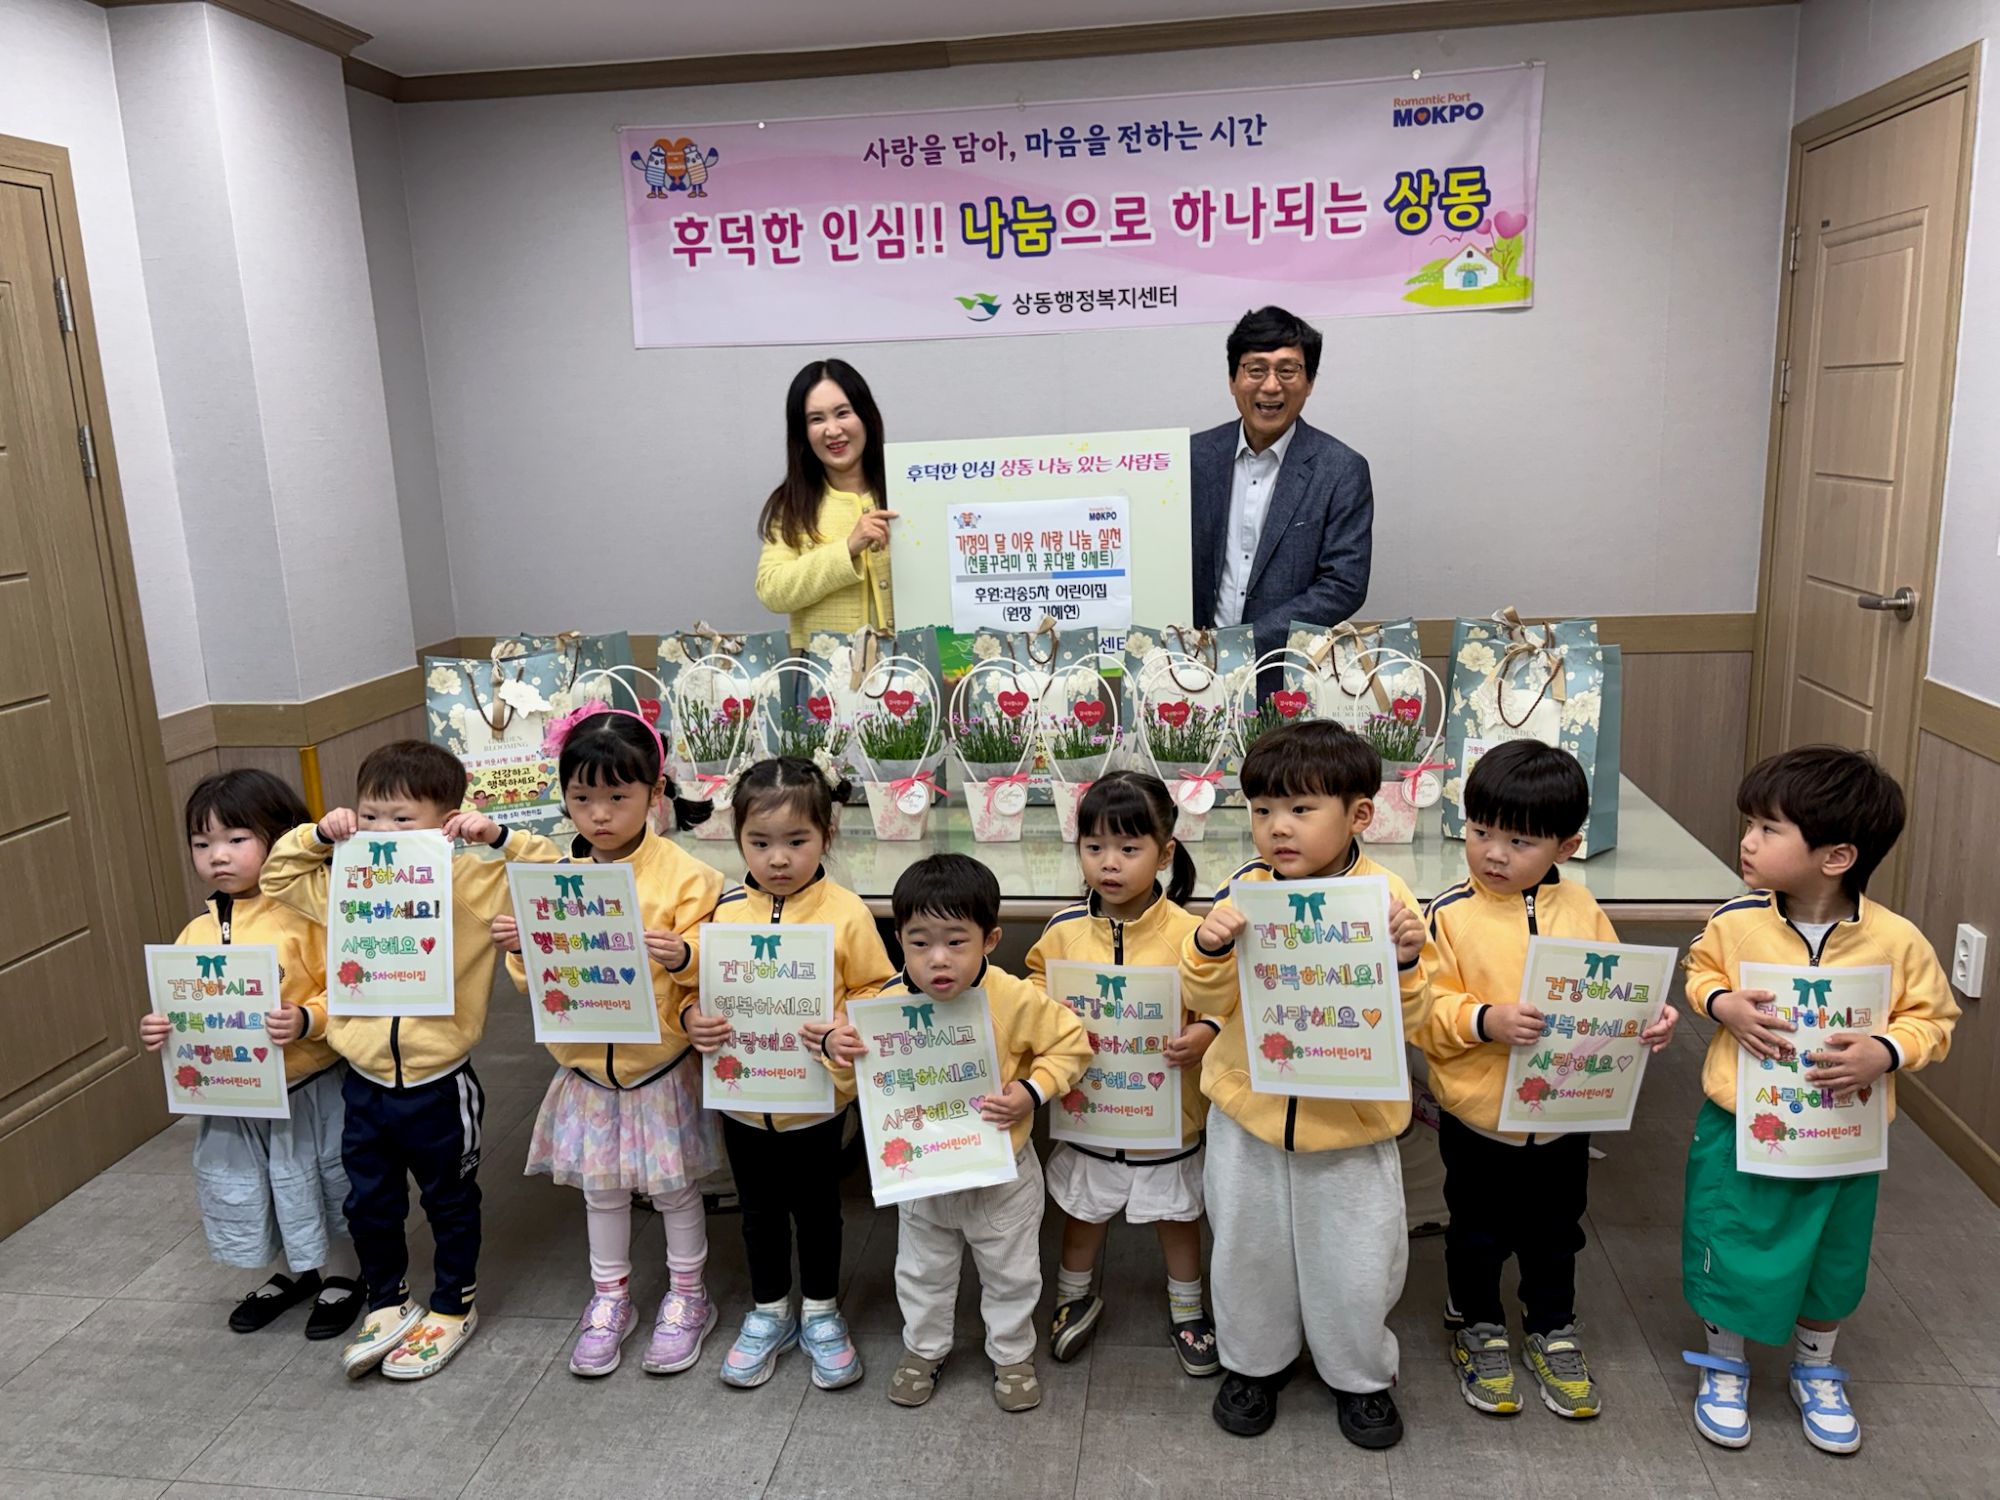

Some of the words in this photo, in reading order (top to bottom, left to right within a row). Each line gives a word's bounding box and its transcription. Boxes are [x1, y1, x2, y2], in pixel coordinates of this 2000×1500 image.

[1394, 95, 1446, 107] Romantic
[1448, 93, 1471, 103] Port
[1393, 102, 1484, 127] MOKPO
[863, 134, 946, 167] 사랑을
[952, 131, 1016, 164] 담아,
[1025, 125, 1110, 158] 마음을
[1117, 122, 1203, 154] 전하는
[1210, 114, 1267, 148] 시간
[672, 208, 804, 268] 후덕한
[823, 204, 945, 262] 인심!!
[960, 195, 1153, 259] 나눔으로
[1173, 181, 1368, 242] 하나되는
[1385, 165, 1491, 236] 상동
[1013, 285, 1178, 316] 상동행정복지센터
[907, 462, 958, 482] 후덕한
[962, 460, 995, 479] 인심
[999, 458, 1033, 477] 상동
[1039, 456, 1073, 474] 나눔
[1077, 455, 1112, 472] 있는
[1116, 452, 1172, 471] 사람들
[1089, 511, 1117, 521] MOKPO
[955, 535, 989, 555] 가정의
[995, 533, 1006, 554] 달
[1012, 532, 1034, 553] 이웃
[1041, 531, 1064, 552] 사랑
[1069, 530, 1092, 551] 나눔
[1098, 527, 1122, 550] 실천
[964, 553, 1021, 574] (선물꾸러미
[1027, 553, 1038, 572] 및
[1043, 551, 1076, 571] 꽃다발
[1081, 549, 1114, 569] 9세트)
[975, 585, 1050, 603] 후원:라송5차
[1056, 583, 1107, 600] 어린이집
[1003, 606, 1032, 622] (원장
[487, 776, 536, 790] 행복하세요
[491, 767, 530, 780] 건강하고
[345, 865, 434, 889] 건강하시고
[339, 899, 440, 923] 행복하세요!
[530, 895, 624, 921] 건강하시고
[341, 935, 418, 959] 사랑해요
[531, 930, 636, 954] 행복하세요!
[1254, 921, 1373, 950] 건강하시고
[362, 969, 426, 983] 송5차어린이집
[542, 965, 620, 988] 사랑해요
[719, 960, 816, 983] 건강하시고
[1254, 962, 1384, 991] 행복하세요!
[168, 978, 264, 1001] 건강하시고
[1546, 976, 1650, 1003] 건강하시고
[569, 998, 631, 1011] 송5차어린이집
[714, 996, 821, 1018] 행복하세요!
[1066, 995, 1163, 1020] 건강하시고
[168, 1011, 270, 1033] 행복하세요
[1262, 1005, 1359, 1031] 사랑해요
[873, 1025, 976, 1057] 건강하시고
[177, 1044, 252, 1065] 사랑해요
[1292, 1046, 1372, 1061] 송5차어린이집
[1527, 1050, 1613, 1076] 사랑해요
[202, 1076, 261, 1088] 송5차어린이집
[742, 1067, 806, 1079] 송5차어린이집
[873, 1059, 987, 1096] 행복하세요!
[1080, 1067, 1146, 1090] 랑해요
[1549, 1087, 1614, 1099] 송5차어린이집
[882, 1099, 968, 1131] 사랑해요
[1088, 1102, 1153, 1117] 송5차어린이집
[1785, 1124, 1861, 1139] 송5차어린이집
[910, 1134, 981, 1159] 송5차어린이집
